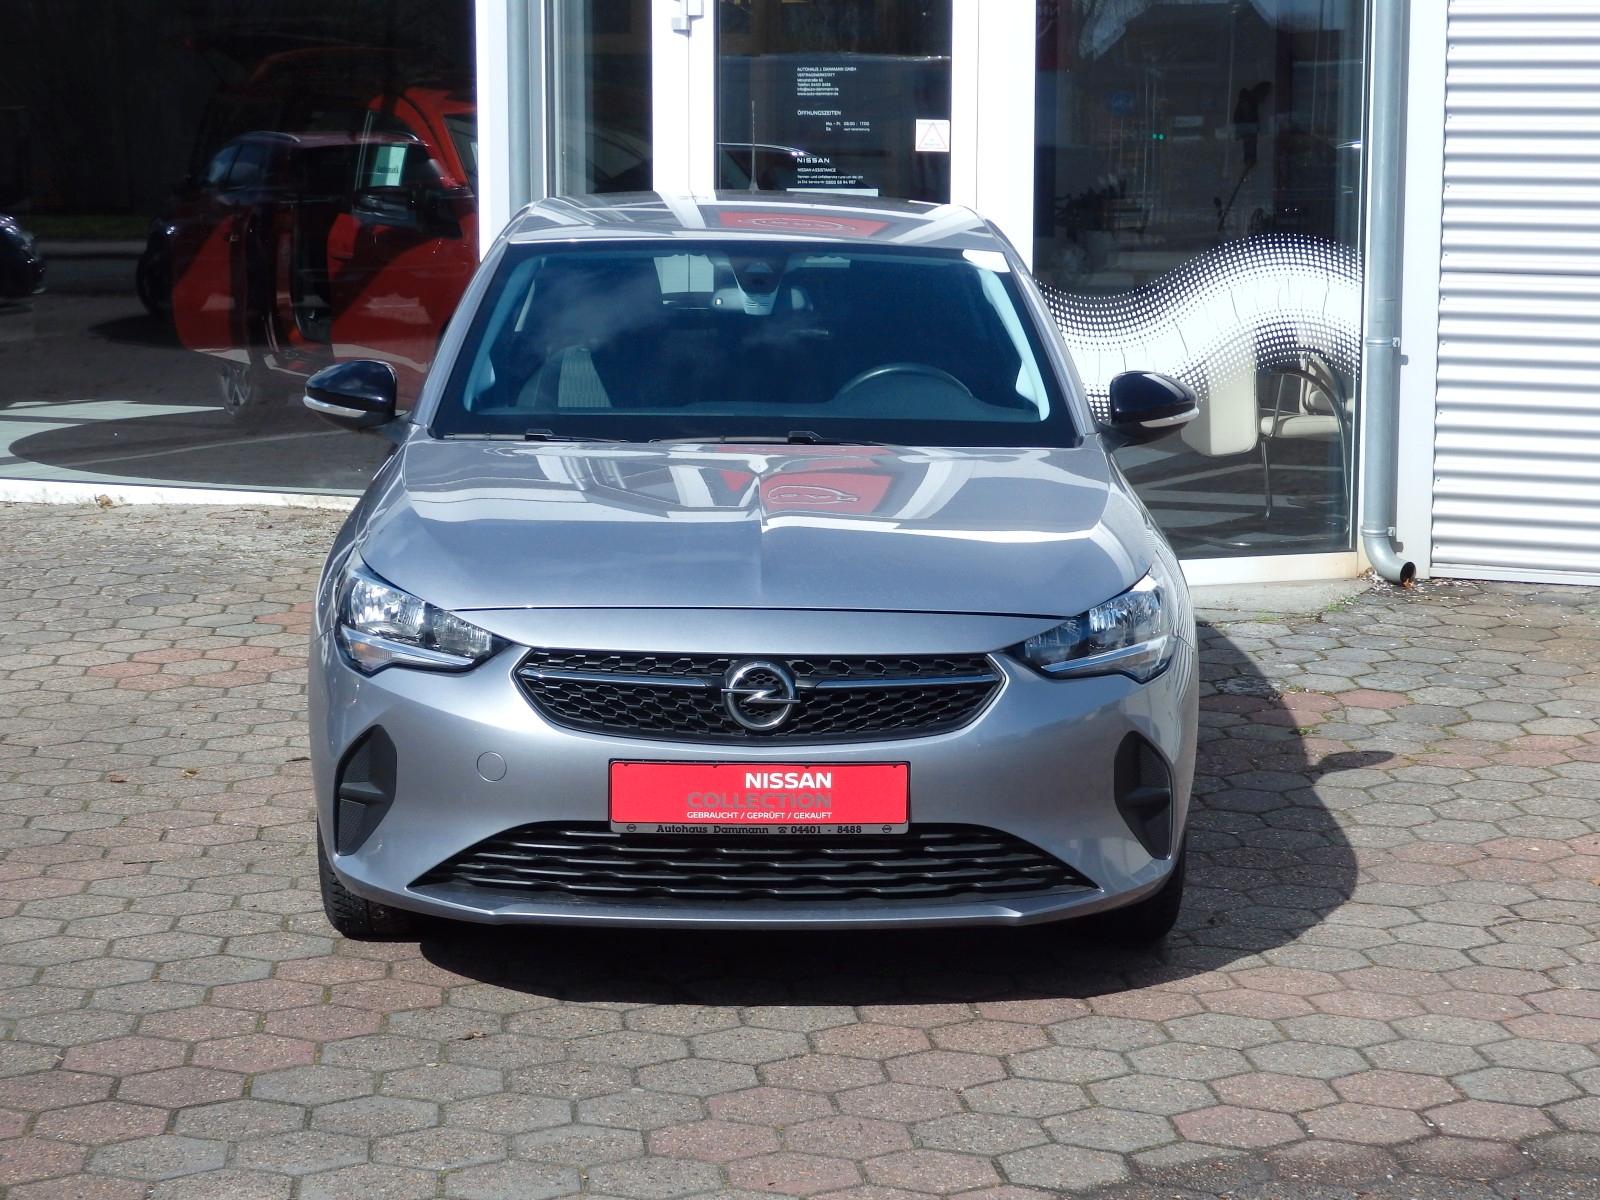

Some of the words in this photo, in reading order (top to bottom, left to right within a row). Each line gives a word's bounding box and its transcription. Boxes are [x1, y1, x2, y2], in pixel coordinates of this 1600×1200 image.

[745, 772, 832, 789] NISSAN
[687, 792, 832, 810] COLLECTION
[686, 811, 739, 819] GEBRAUCHT
[746, 811, 786, 819] GEPRÜFT
[793, 812, 833, 820] GEKAUFT
[655, 824, 708, 834] Autohaus
[713, 825, 770, 834] Dammann
[791, 825, 821, 834] 04401
[837, 825, 862, 834] 8488
